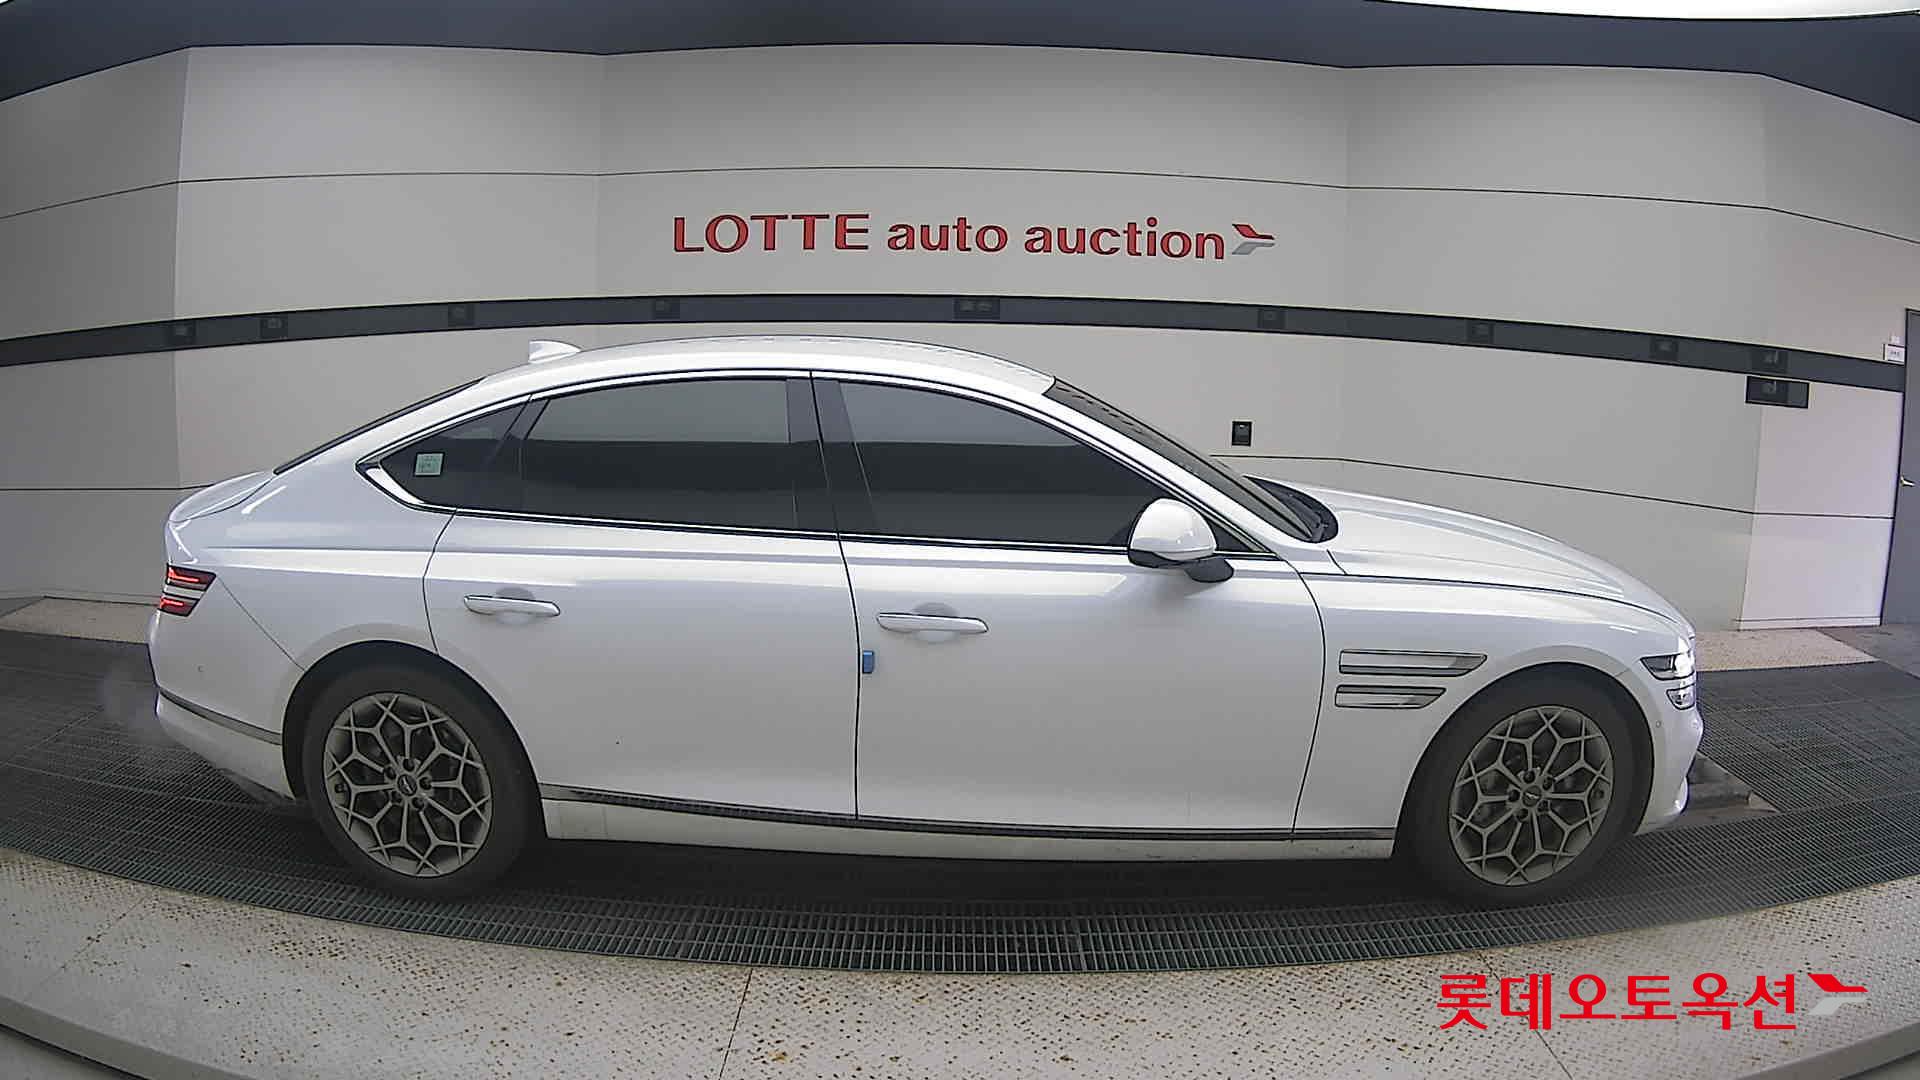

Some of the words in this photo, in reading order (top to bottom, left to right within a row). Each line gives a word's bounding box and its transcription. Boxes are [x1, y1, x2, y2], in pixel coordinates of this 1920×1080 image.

[673, 214, 869, 252] LOTTE
[887, 216, 1008, 253] auto
[1024, 217, 1225, 260] auction
